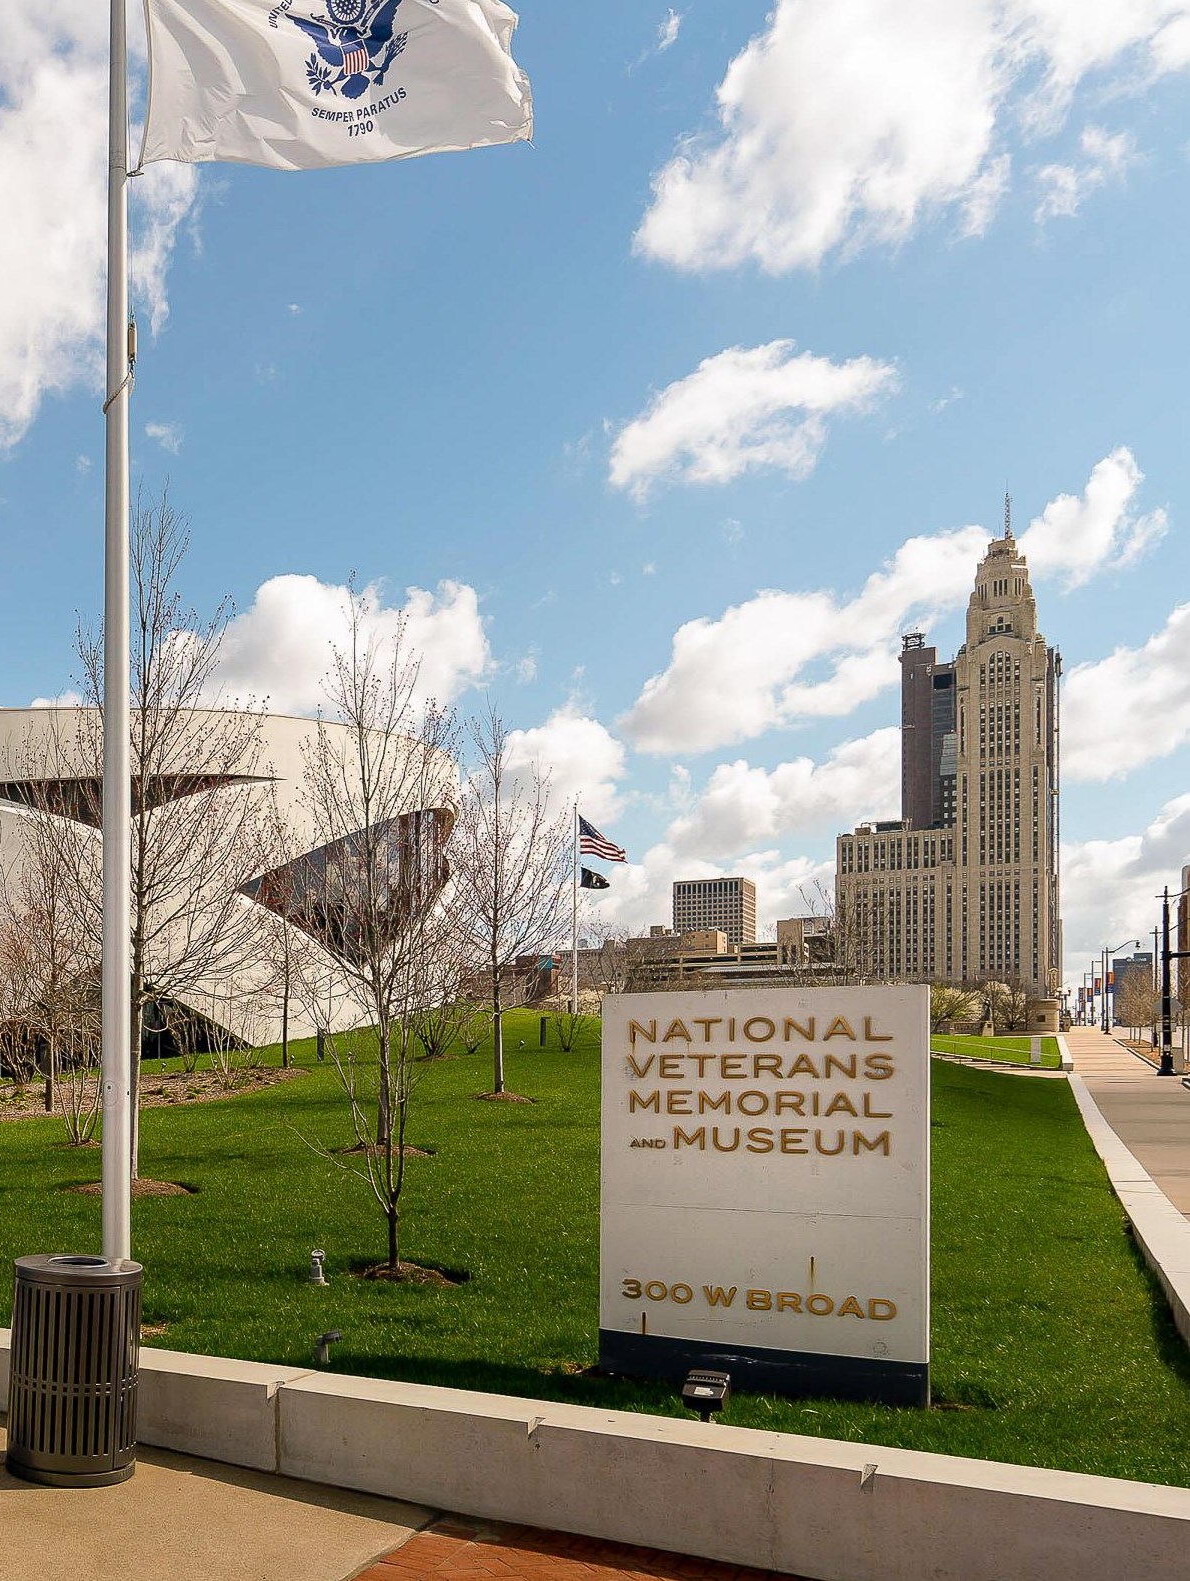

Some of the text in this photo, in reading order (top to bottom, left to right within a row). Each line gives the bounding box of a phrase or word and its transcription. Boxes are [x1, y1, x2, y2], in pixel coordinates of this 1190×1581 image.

[311, 87, 407, 123] SEMPER PARATUS
[347, 120, 374, 137] 1790
[628, 1016, 894, 1043] NATIONAL
[626, 1053, 895, 1080] VETERANS
[629, 1090, 894, 1118] MEMORIAL
[629, 1125, 890, 1157] AND MUSEUM
[621, 1278, 898, 1321] 300 W BROAD
